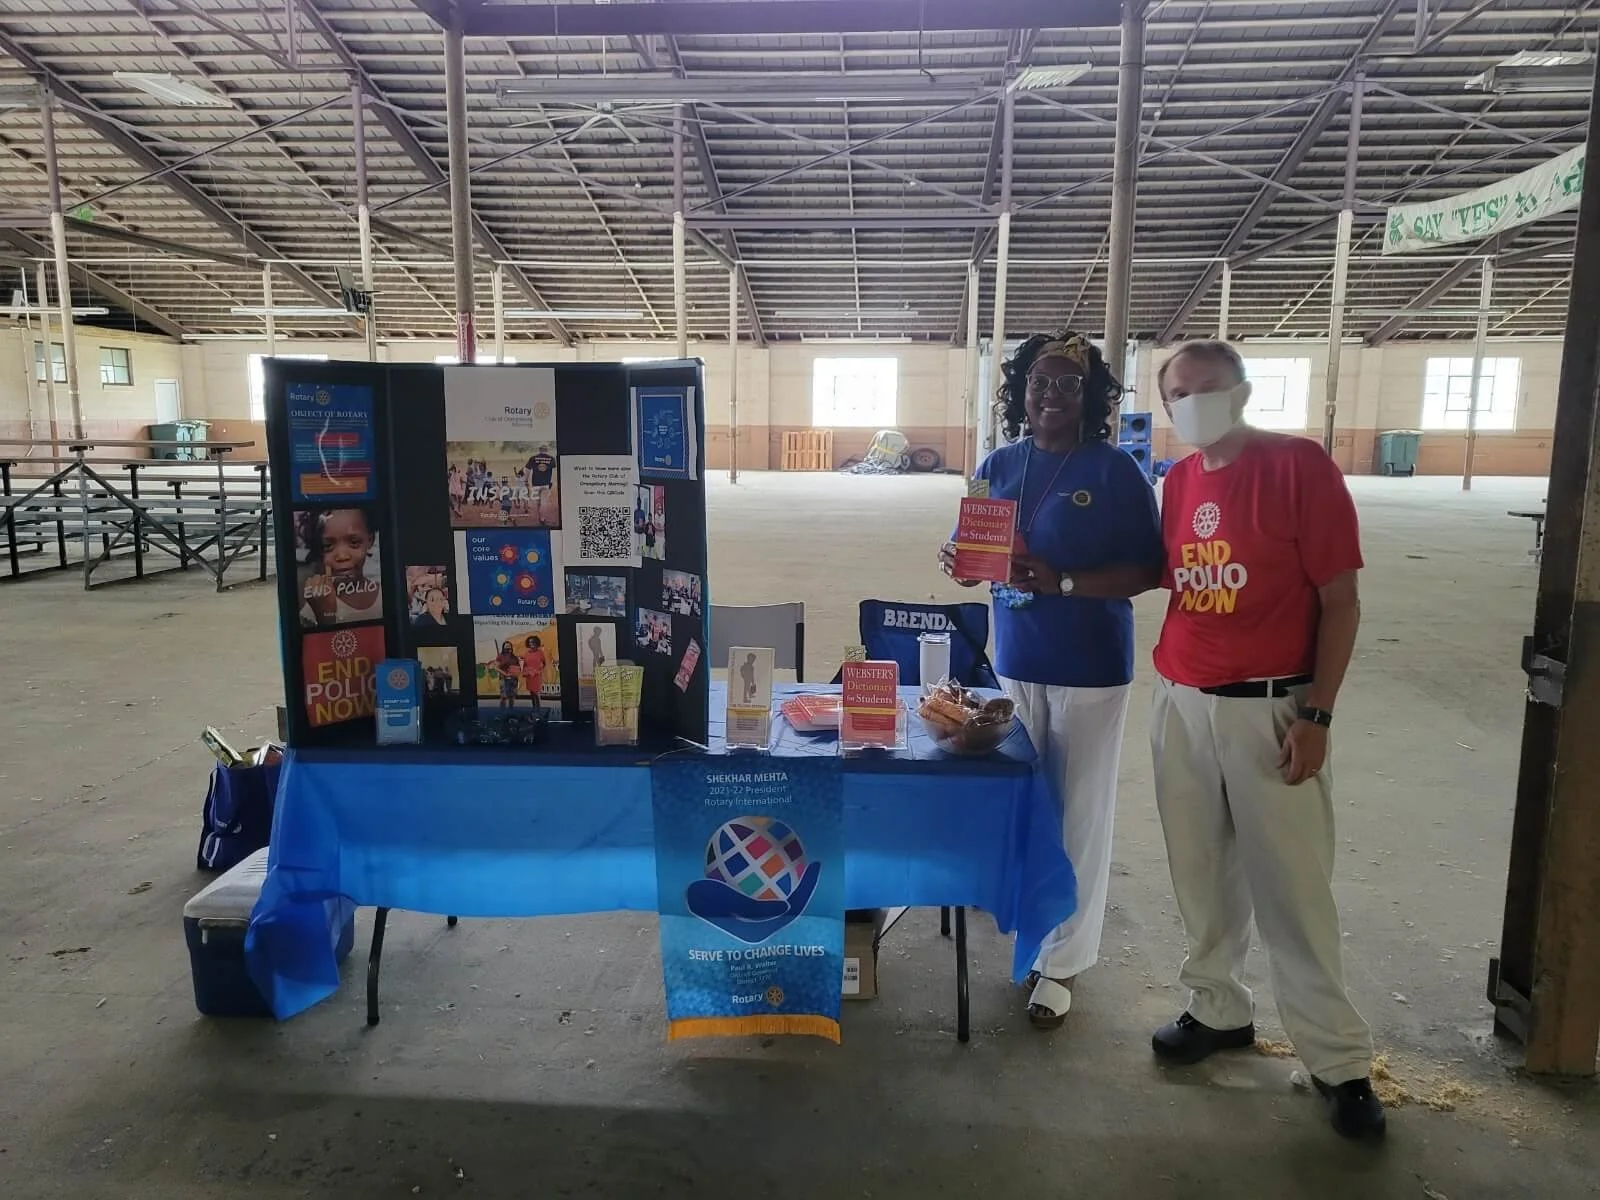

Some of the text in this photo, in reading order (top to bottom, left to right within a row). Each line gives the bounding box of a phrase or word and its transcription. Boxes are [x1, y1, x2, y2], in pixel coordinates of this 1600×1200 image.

[1413, 212, 1444, 241] SAY
[290, 392, 315, 403] Rotary
[336, 410, 368, 418] ROTARY
[504, 406, 532, 416] Rotary
[467, 486, 541, 502] INSPIRE
[961, 503, 1011, 517] WEBSTER'S
[961, 516, 1009, 533] Dictionary
[969, 530, 1008, 542] Students
[473, 553, 499, 561] values
[1181, 540, 1231, 569] END
[1174, 562, 1248, 593] POLIO
[303, 581, 378, 599] END POLIO
[1178, 588, 1238, 614] NOW
[883, 609, 958, 631] BRENDA
[317, 656, 371, 684] END
[847, 667, 894, 679] WEBSTER'S
[847, 680, 892, 694] Dictionary
[856, 693, 893, 704] Students
[315, 696, 377, 724] NOW
[706, 772, 788, 783] SHEKHAR MEHTA
[709, 785, 786, 795] 2021-22 President
[704, 792, 792, 807] Rotary International
[688, 945, 825, 962] SERVE TO CHANGE LIVES
[732, 992, 763, 1004] Rotary
